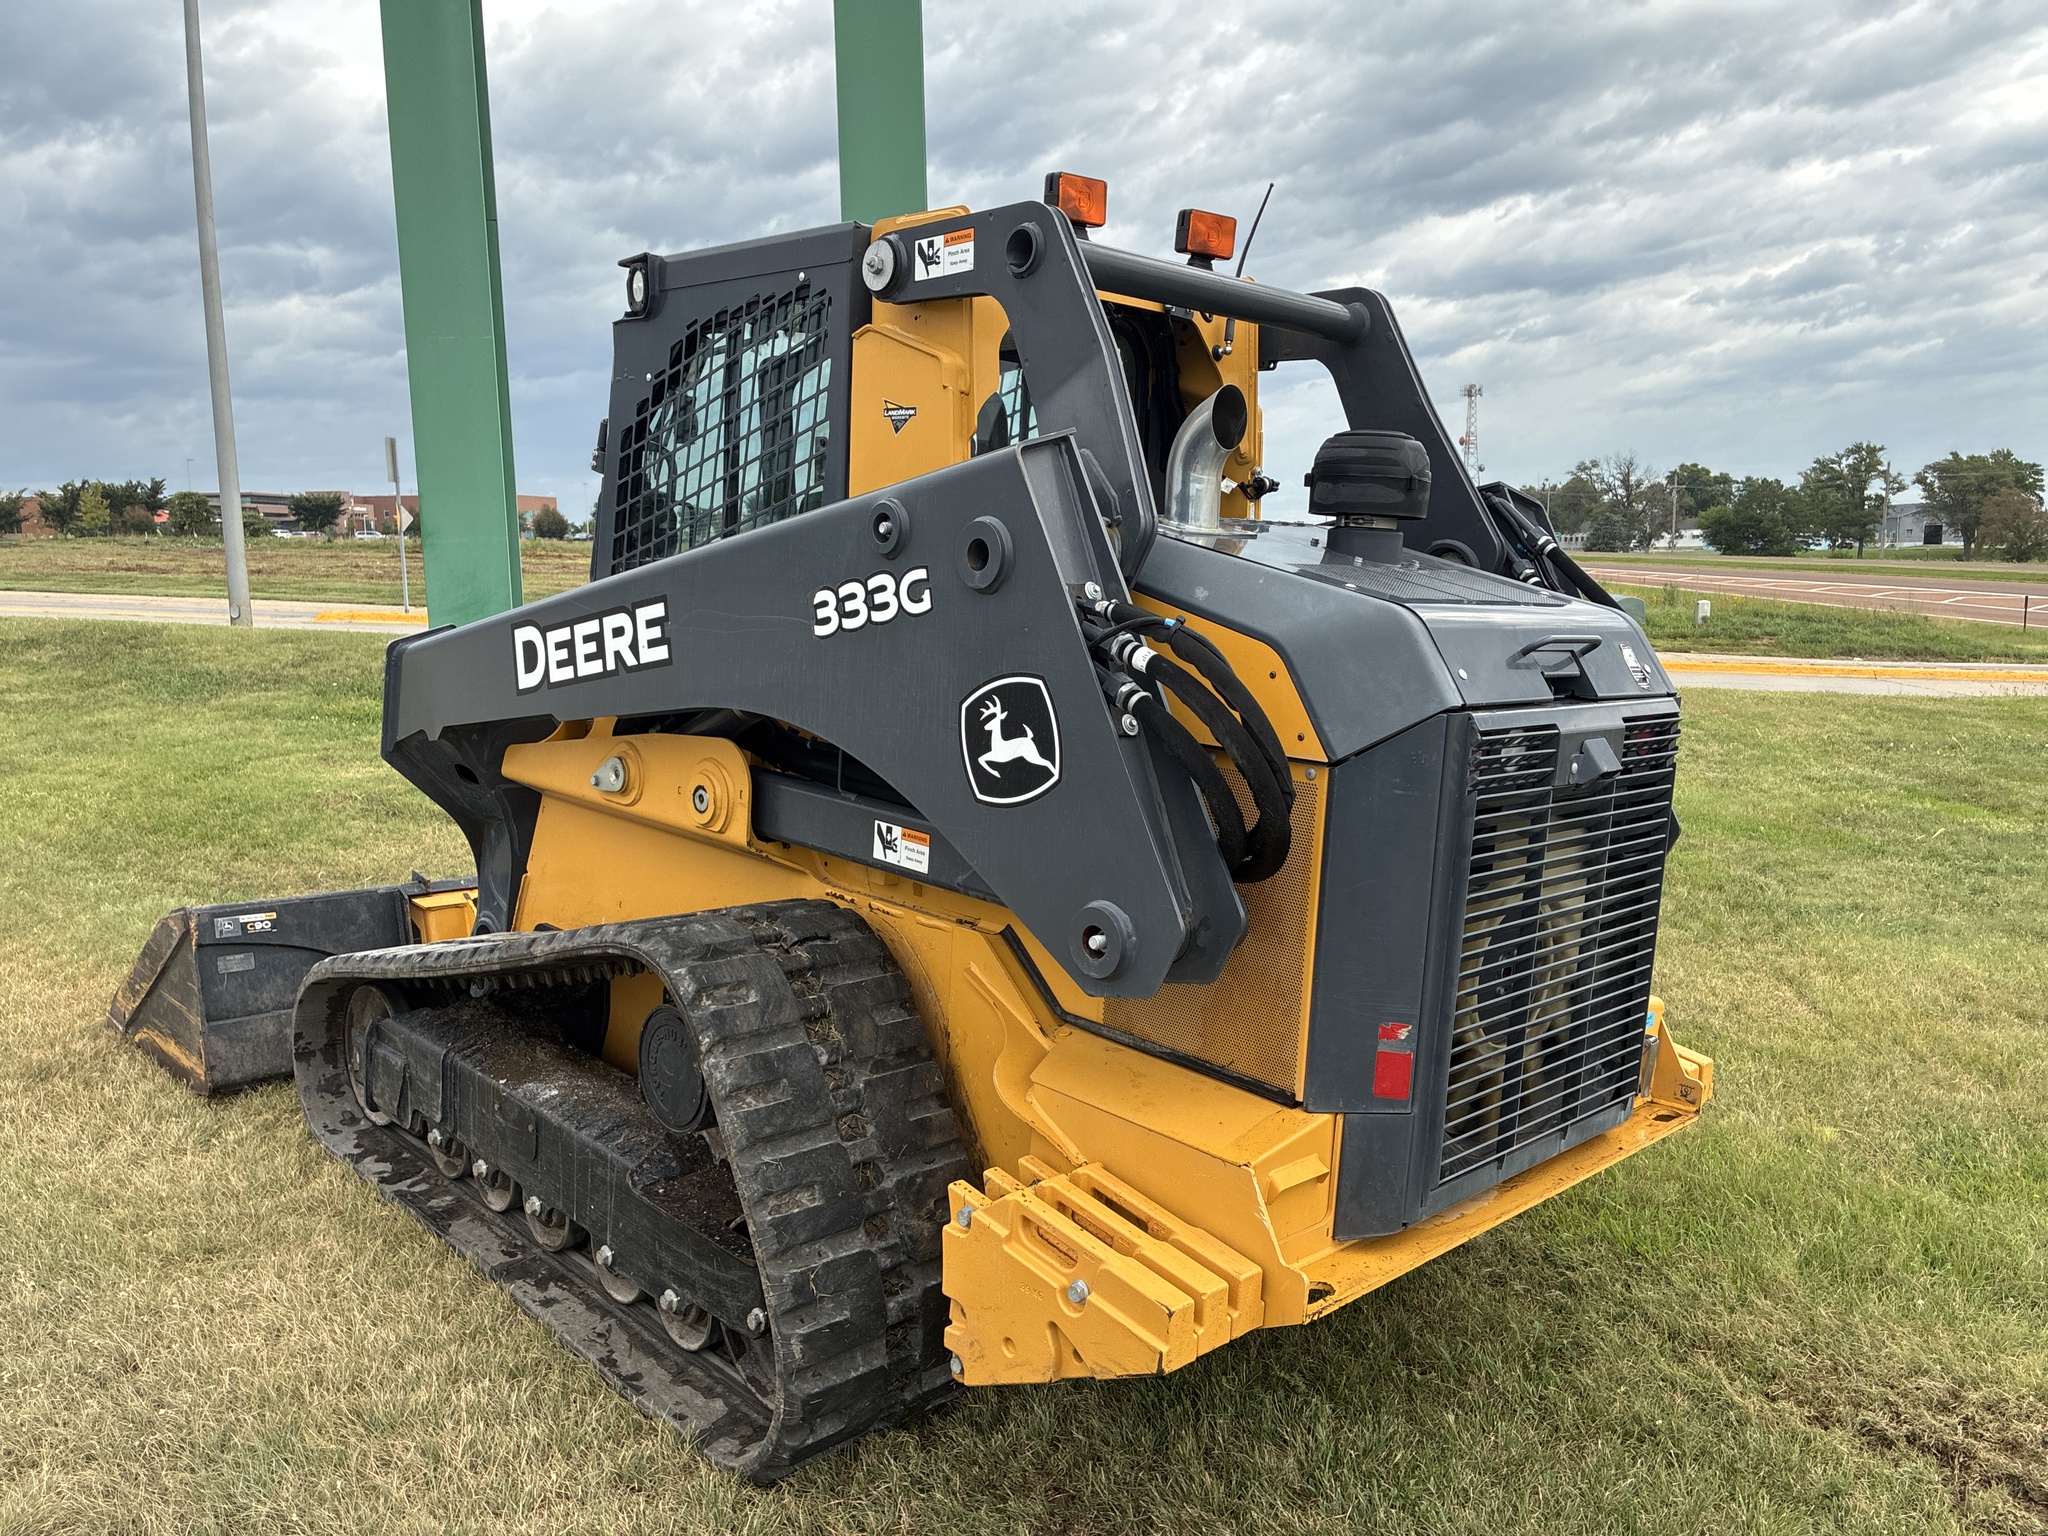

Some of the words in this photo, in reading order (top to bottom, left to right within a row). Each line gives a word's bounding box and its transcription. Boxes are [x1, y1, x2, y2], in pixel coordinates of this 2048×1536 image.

[949, 233, 972, 242] WARNING
[813, 568, 932, 637] 333G
[513, 601, 670, 690] DEERE
[906, 832, 928, 844] WARNING
[904, 845, 916, 854] Pinch
[246, 920, 272, 931] C90
